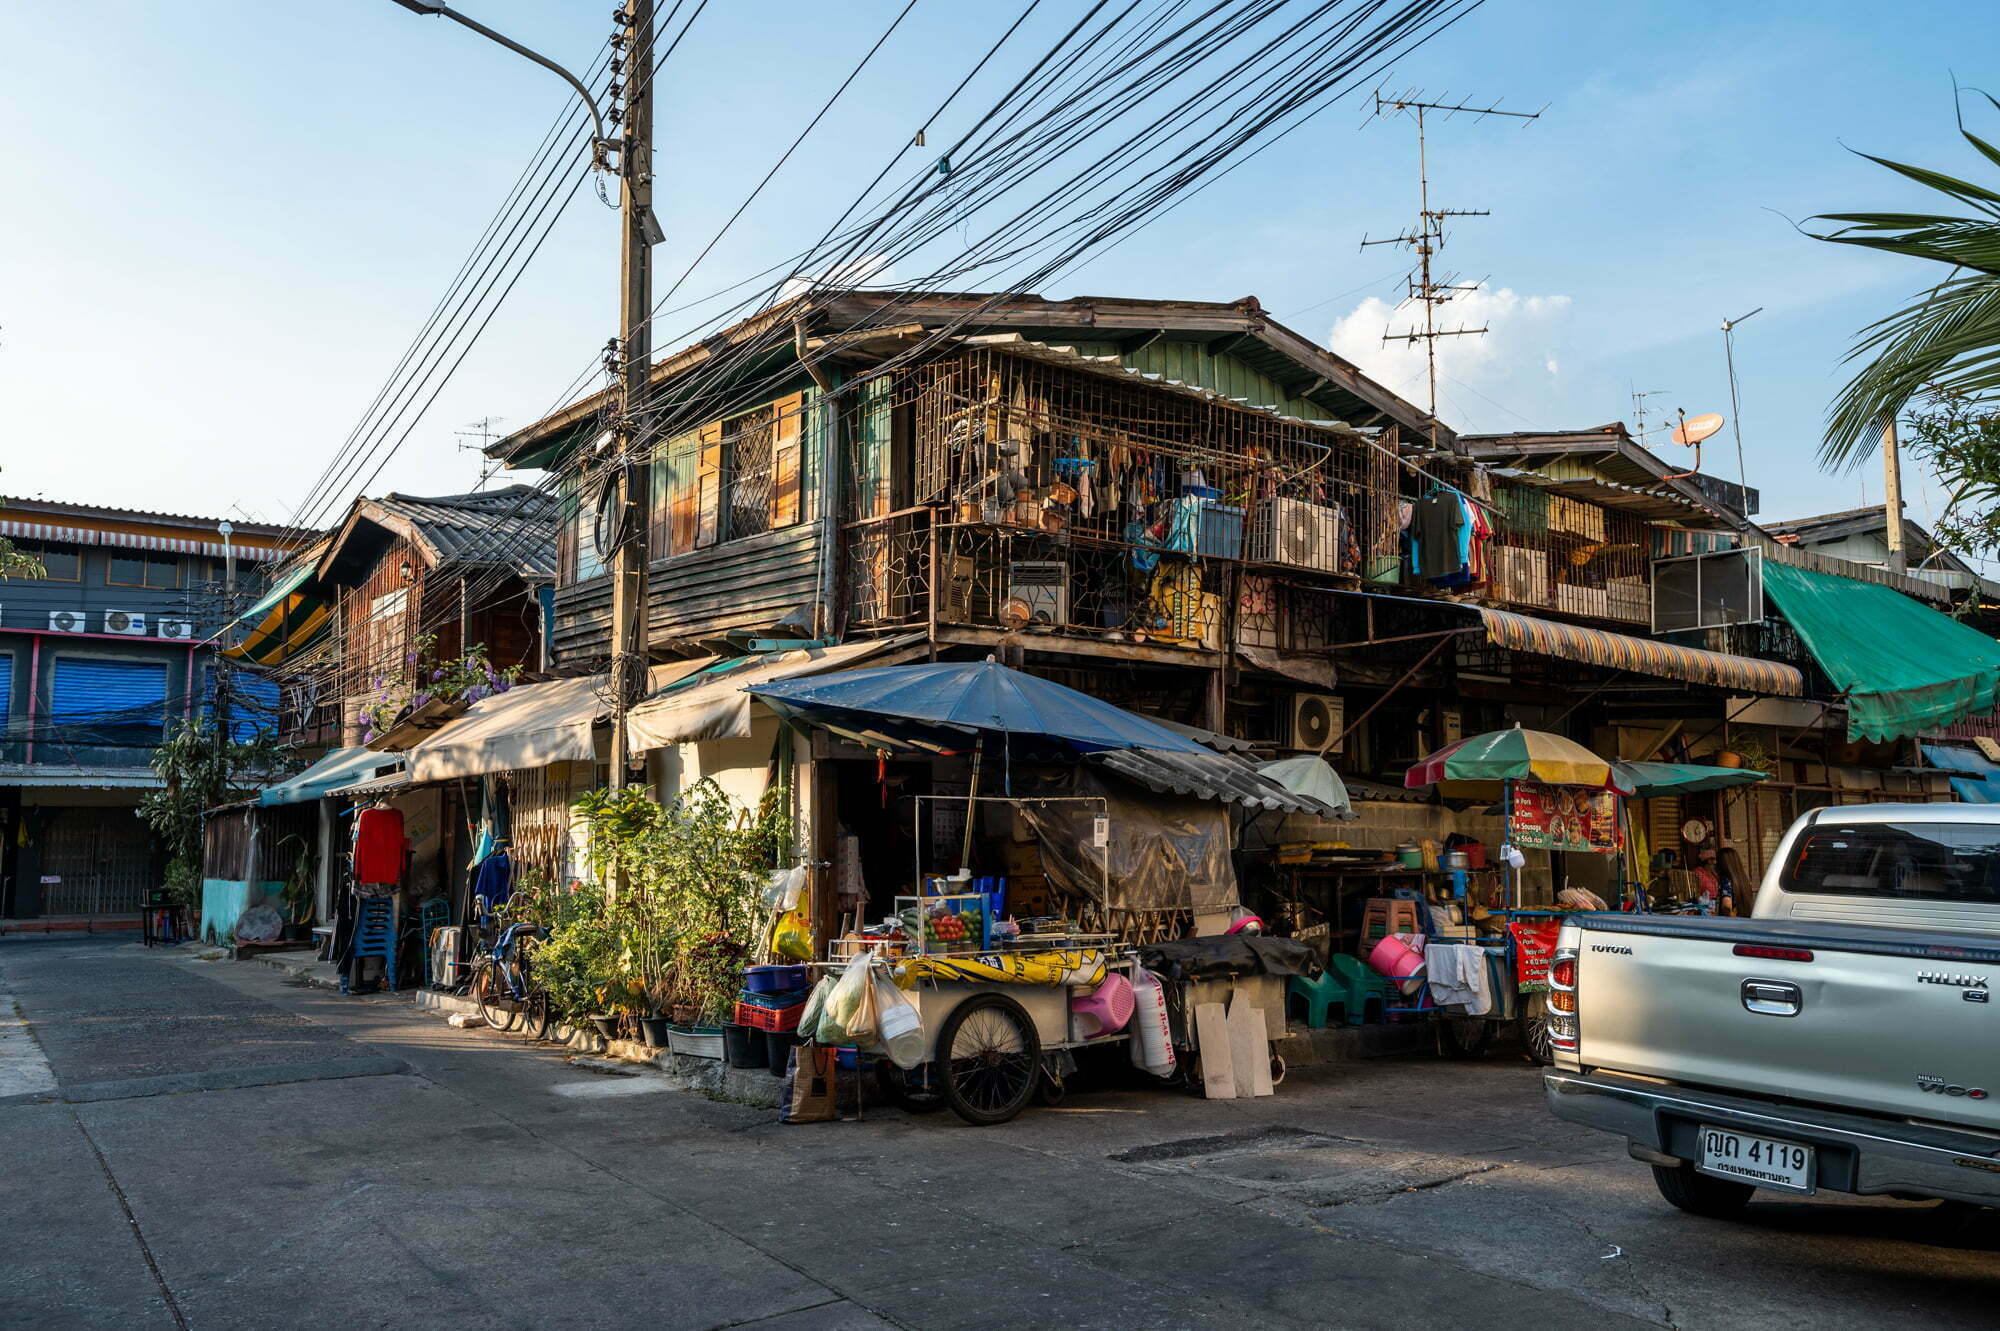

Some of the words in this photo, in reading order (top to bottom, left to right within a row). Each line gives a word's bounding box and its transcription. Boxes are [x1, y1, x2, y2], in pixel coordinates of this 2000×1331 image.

[1520, 798, 1532, 806] Pork
[1590, 944, 1633, 955] TOYOTA
[1917, 971, 1988, 988] HILUX
[1918, 1074, 1943, 1083] HILUX
[1707, 1132, 1739, 1158] ญถ
[1748, 1140, 1805, 1171] 4119
[1717, 1163, 1790, 1183] กรงเทพมหานคร
